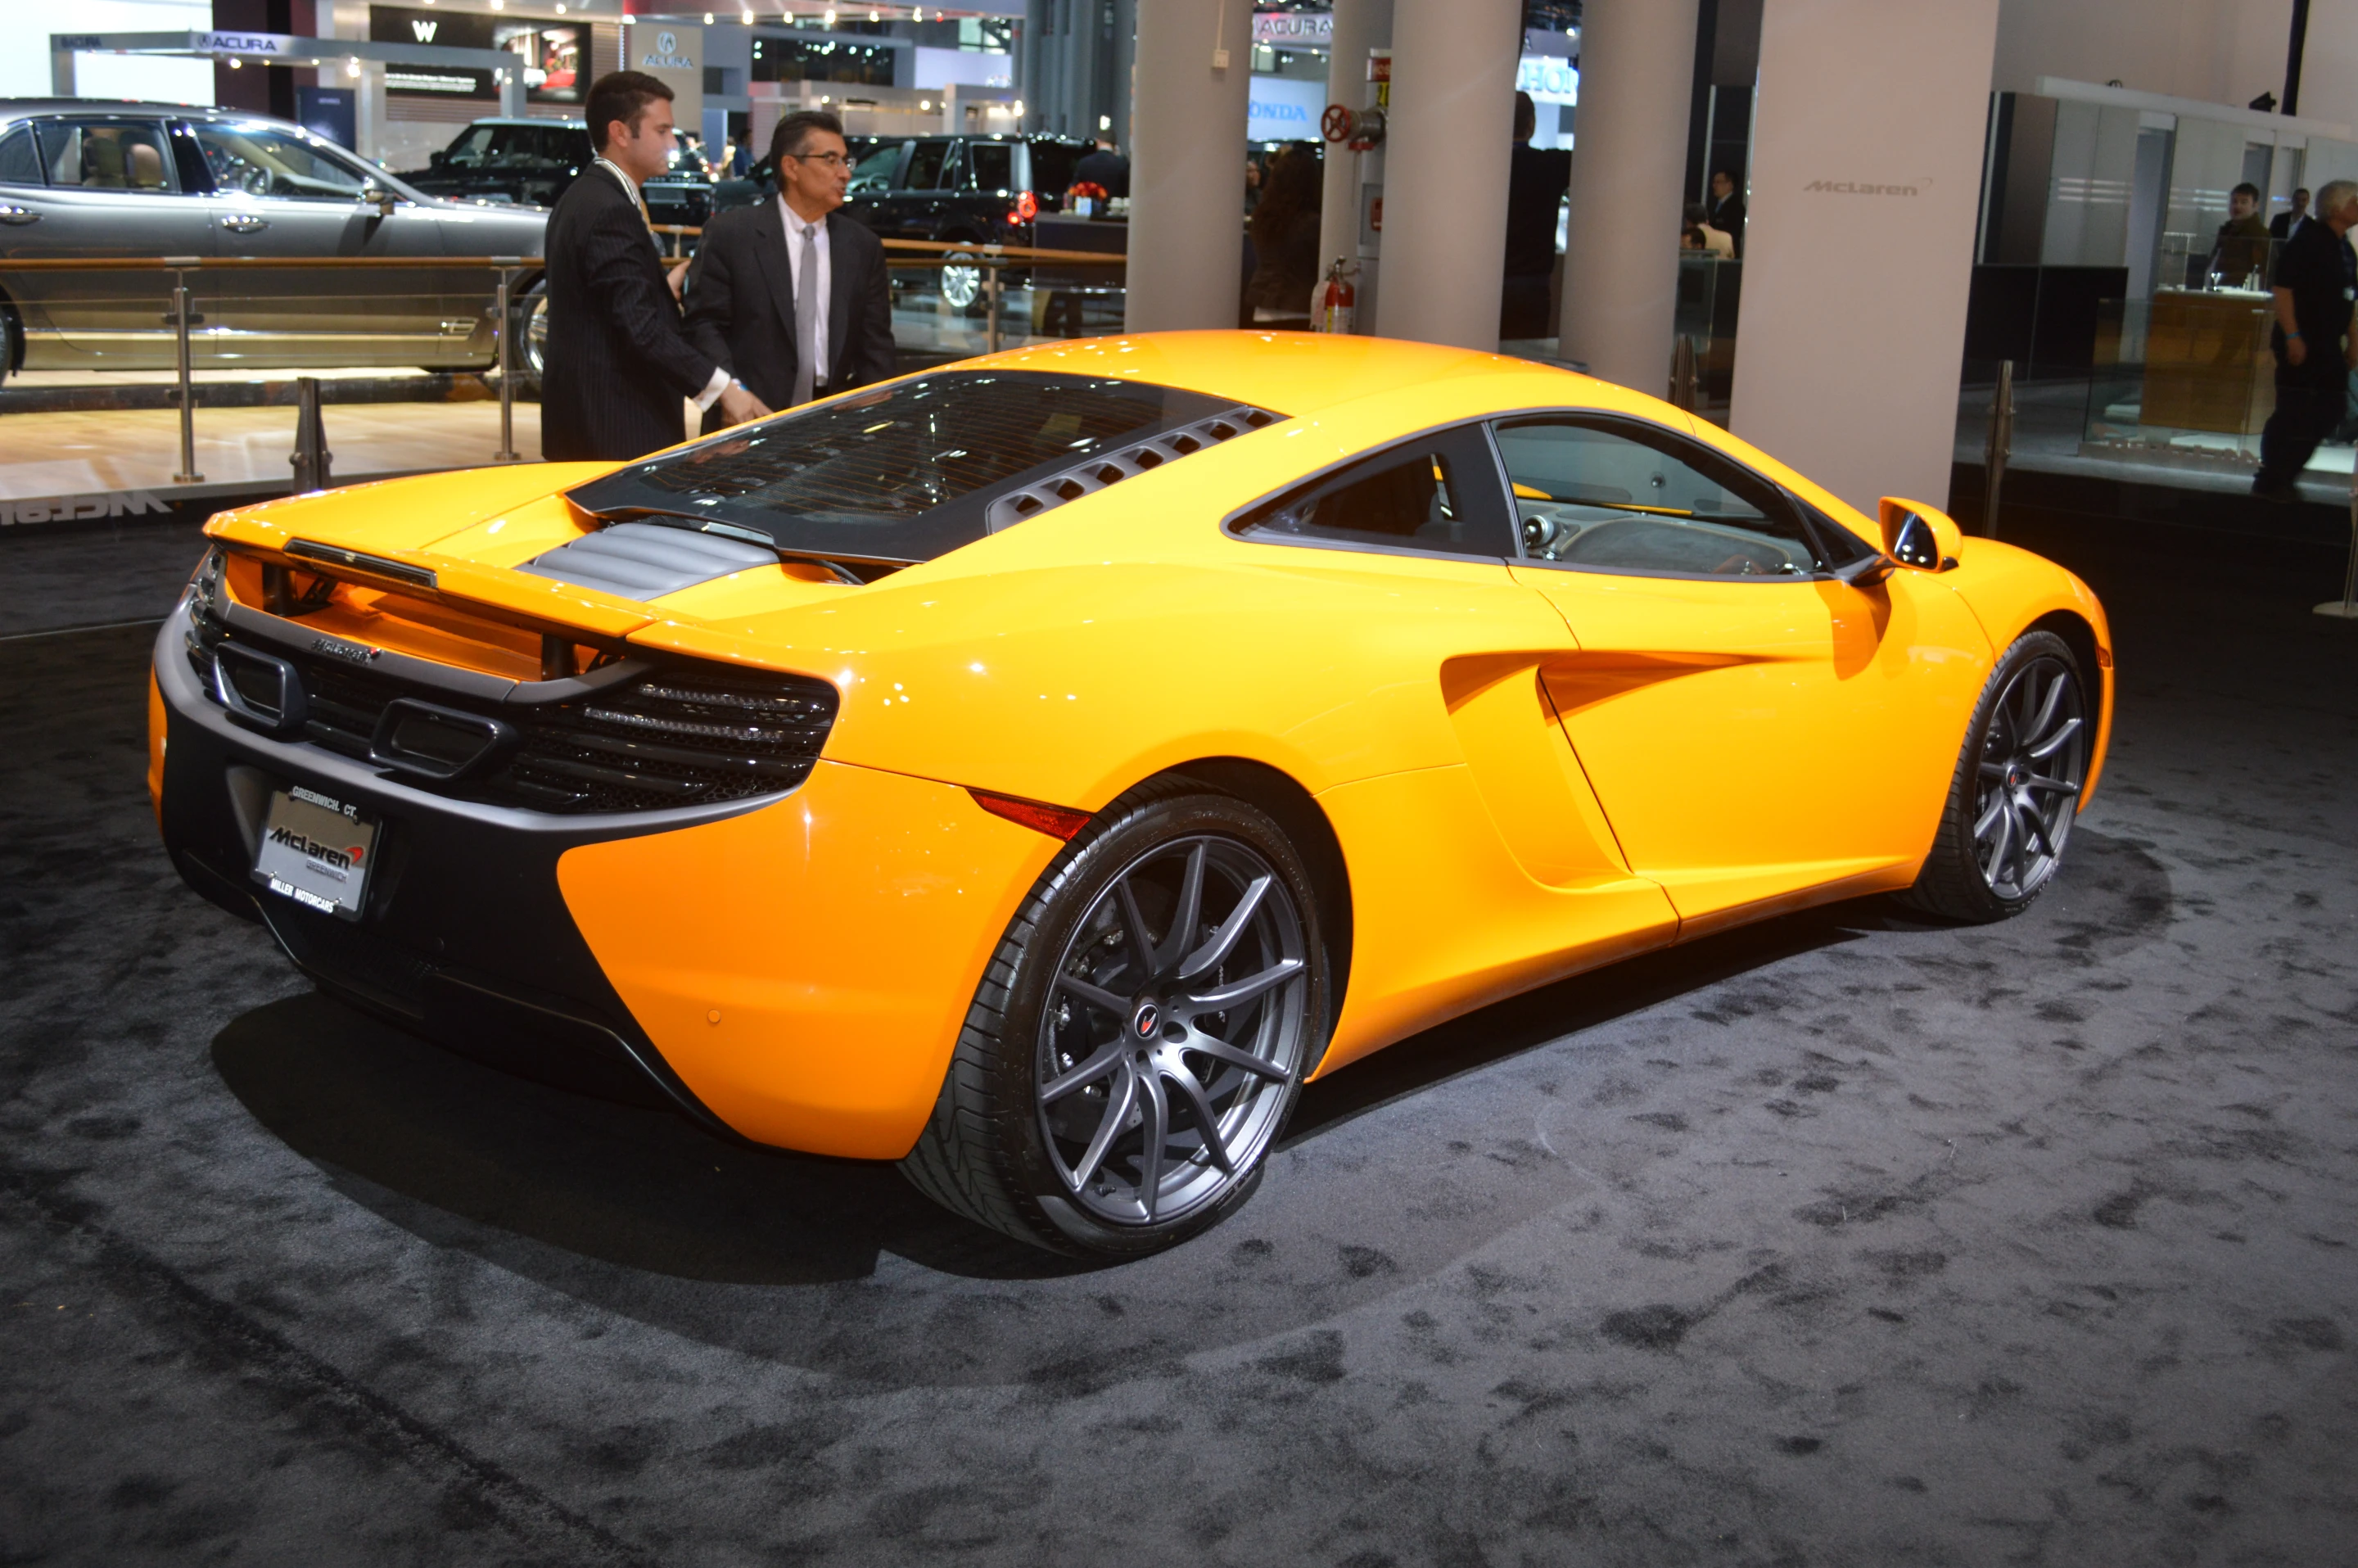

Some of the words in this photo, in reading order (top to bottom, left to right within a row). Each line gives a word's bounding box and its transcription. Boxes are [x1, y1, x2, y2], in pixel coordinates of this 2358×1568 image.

[412, 20, 437, 43] W
[1261, 18, 1333, 36] ACURA
[212, 36, 277, 52] ACURA
[642, 54, 693, 69] ACURA
[1803, 180, 1918, 197] McLaren
[269, 827, 351, 870] McLaren
[306, 861, 348, 883] GREENWICH
[270, 878, 293, 897] MILLER
[296, 888, 334, 914] MOTORCARS
